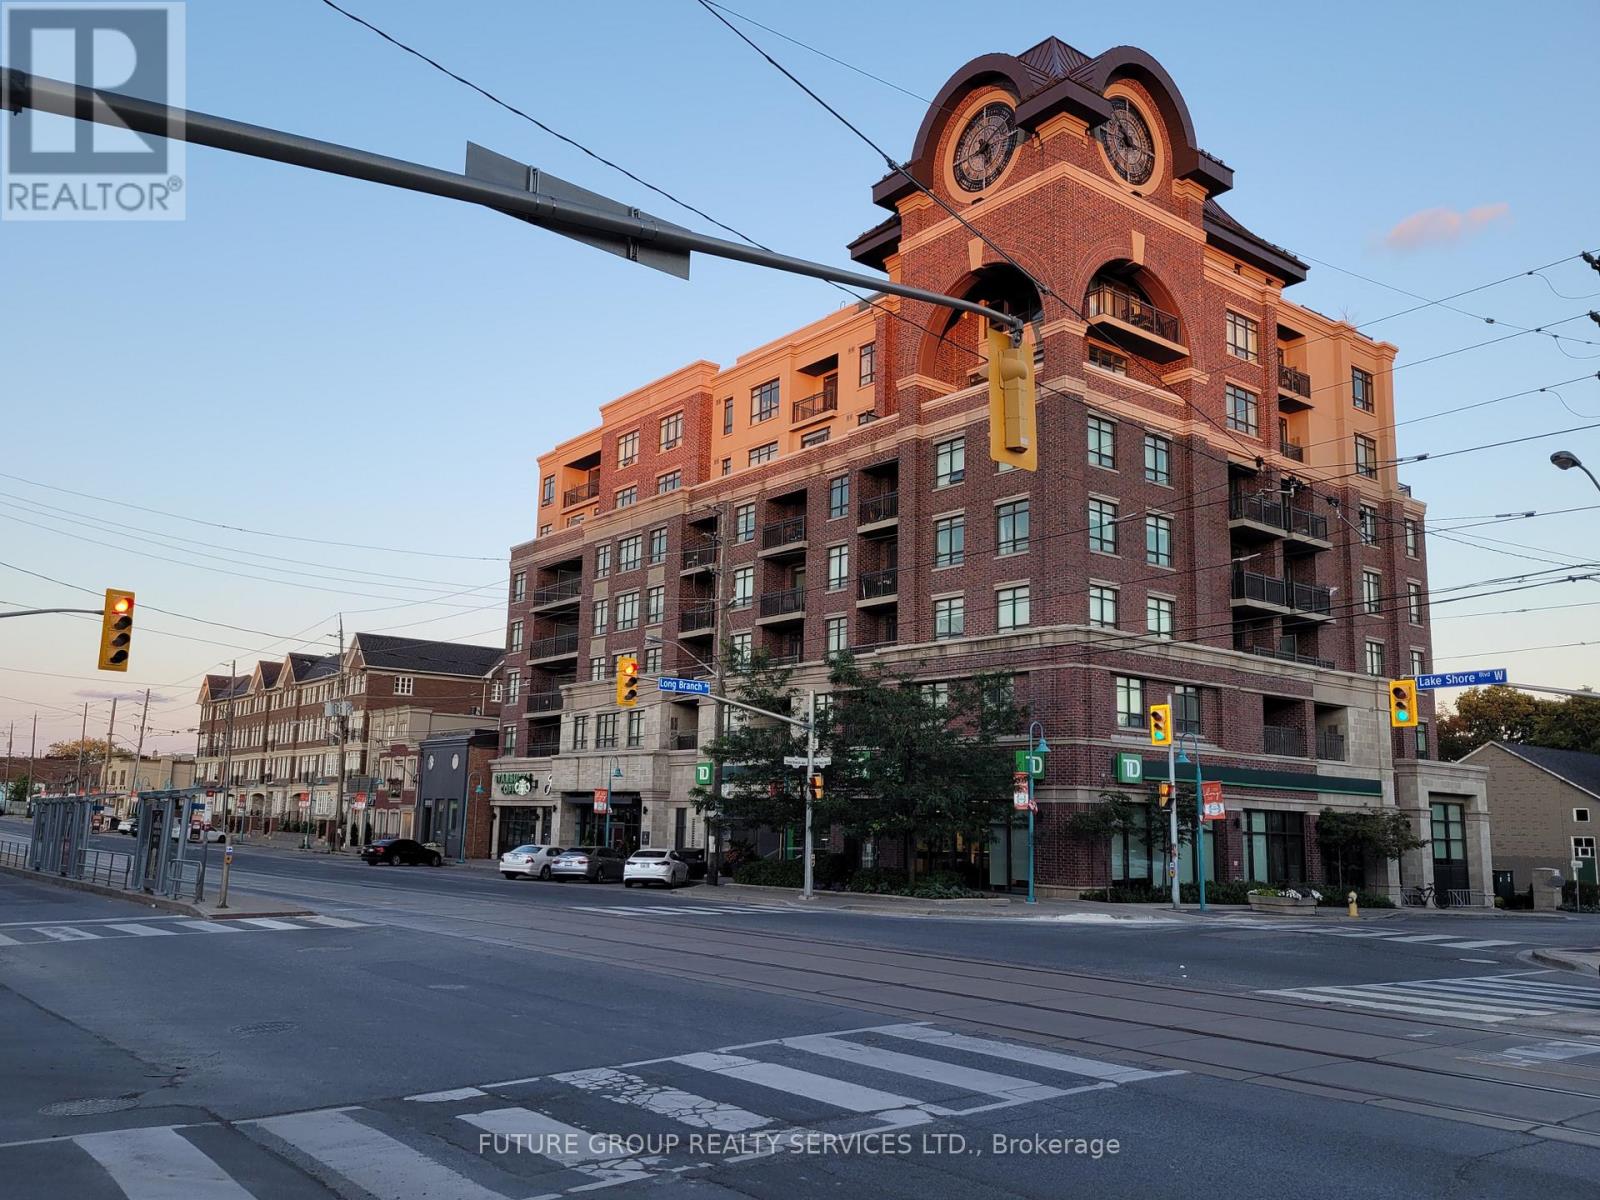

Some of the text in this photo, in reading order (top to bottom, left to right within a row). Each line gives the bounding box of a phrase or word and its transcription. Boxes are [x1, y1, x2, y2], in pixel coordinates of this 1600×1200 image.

[660, 679, 677, 691] Long
[678, 680, 703, 691] Branch
[1419, 670, 1504, 687] Lake Shore Blvd W
[697, 766, 709, 780] TD
[1122, 758, 1141, 778] TD
